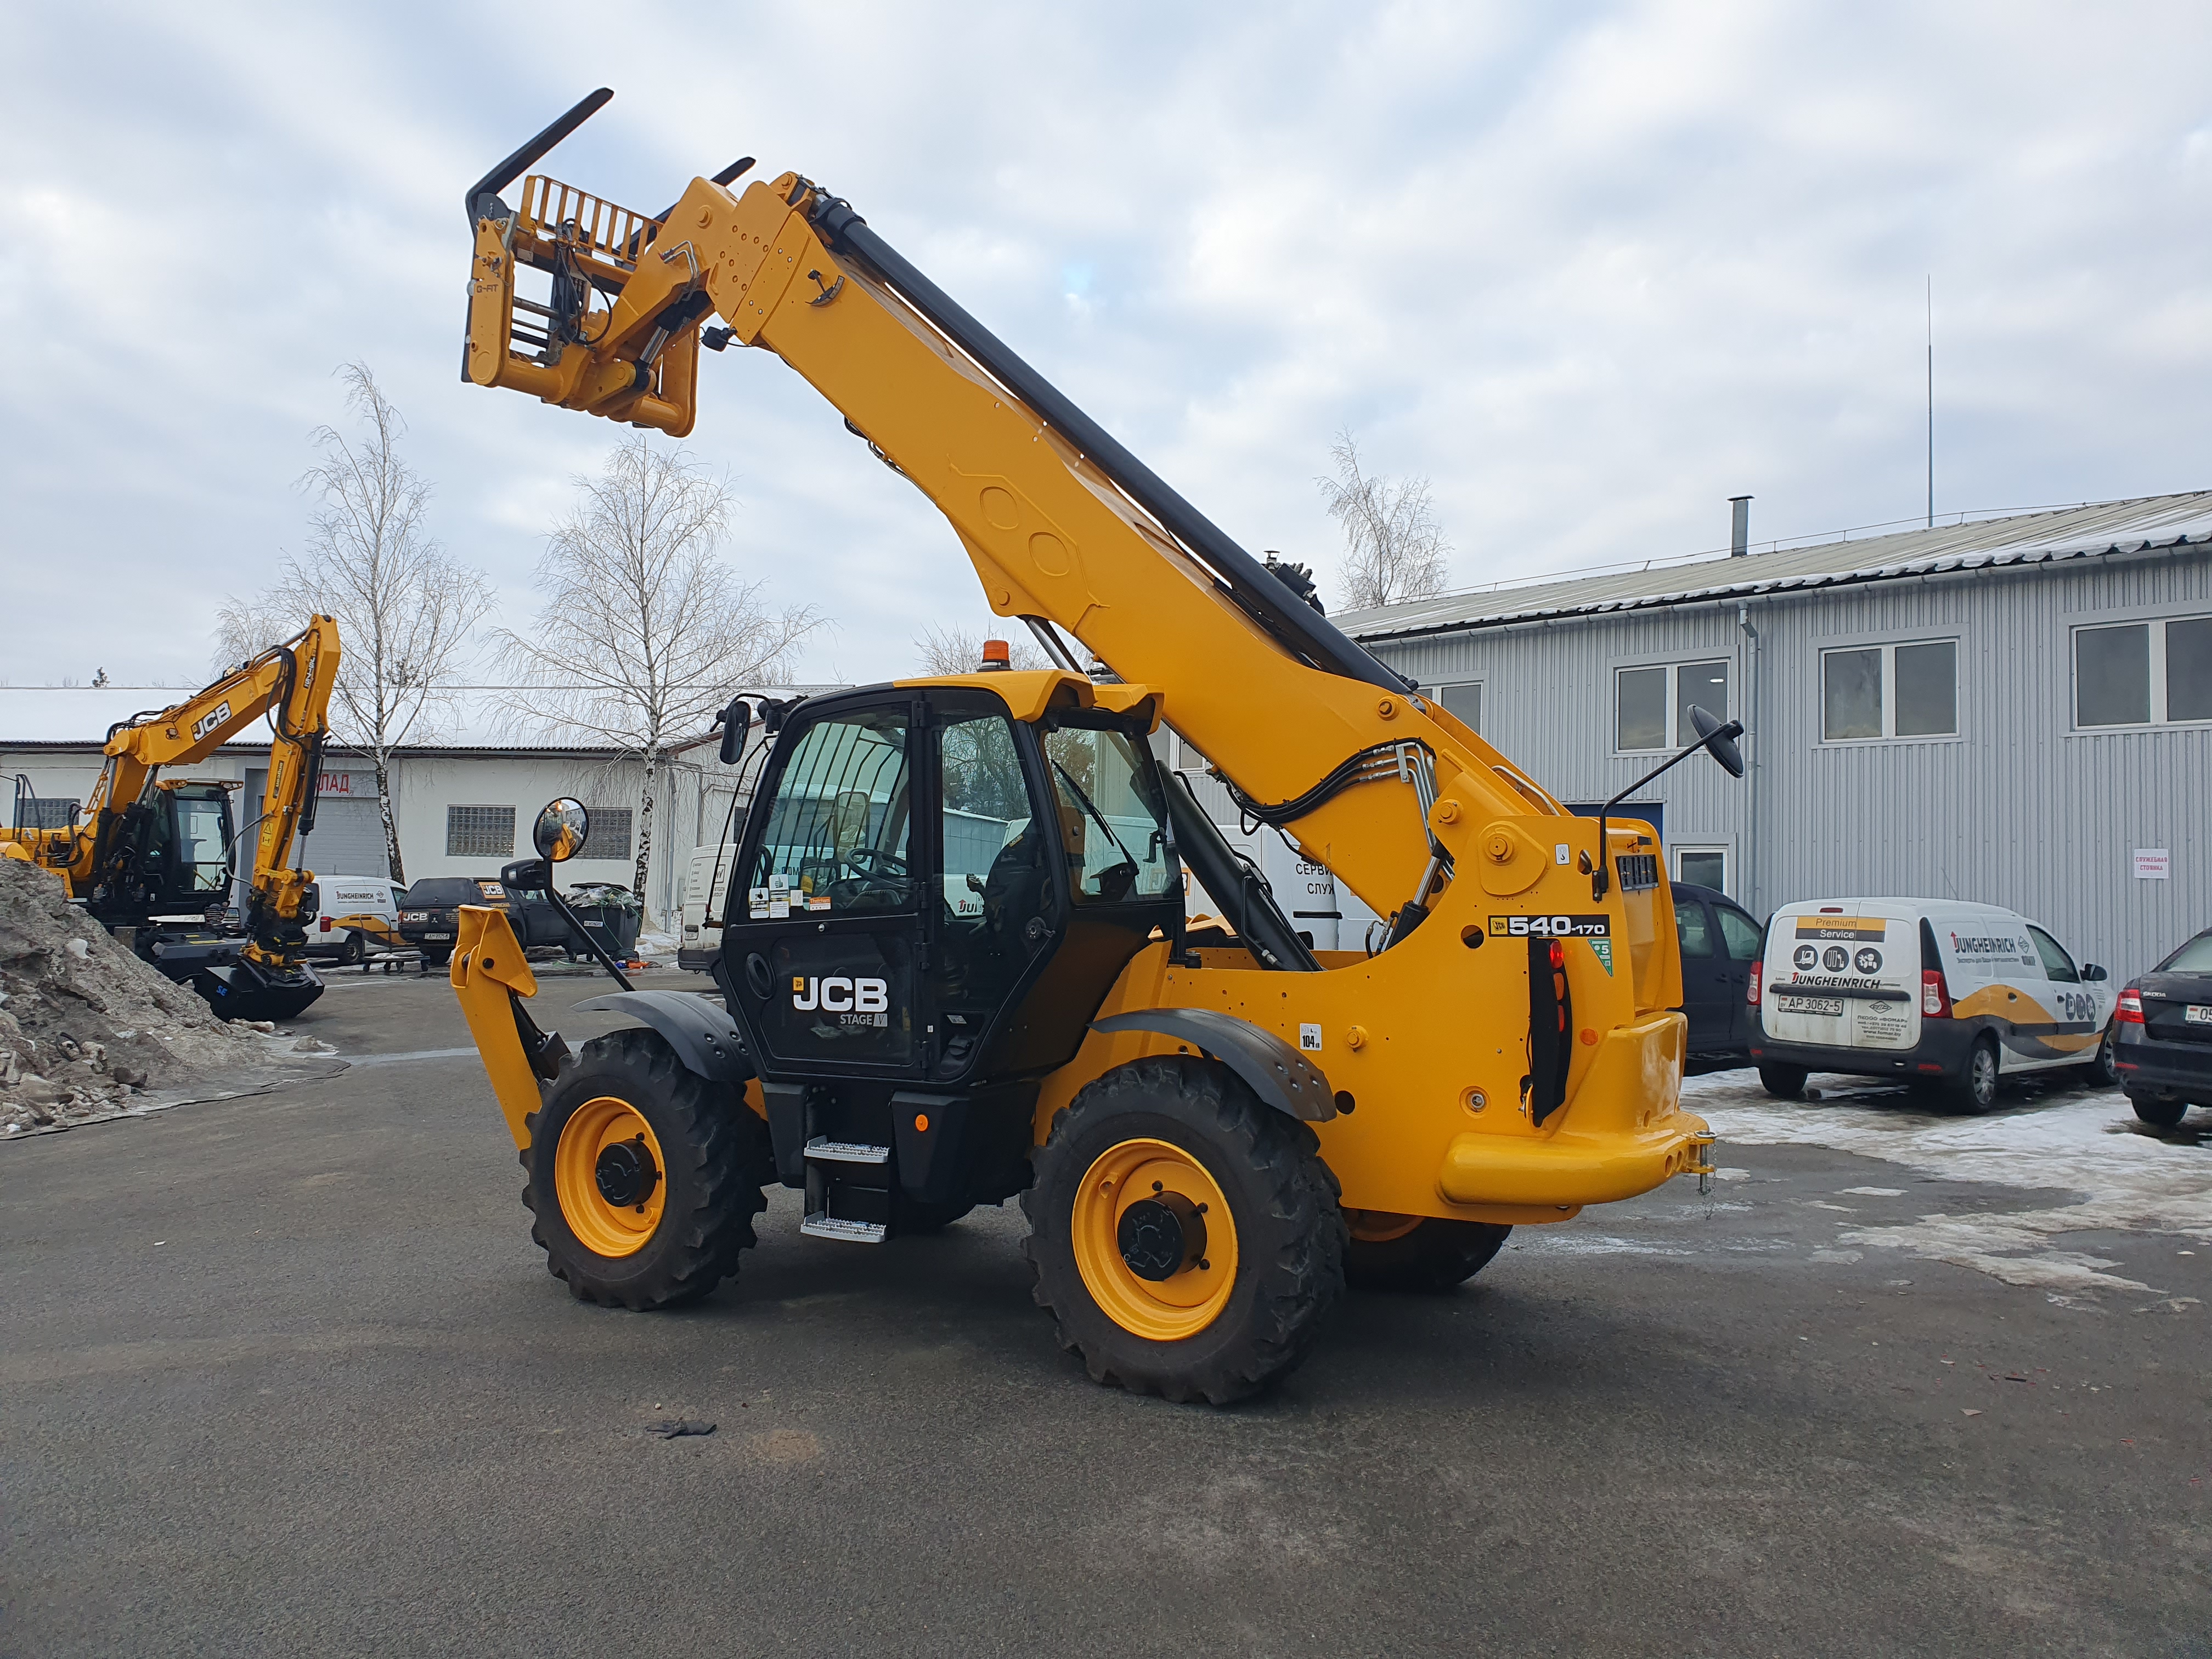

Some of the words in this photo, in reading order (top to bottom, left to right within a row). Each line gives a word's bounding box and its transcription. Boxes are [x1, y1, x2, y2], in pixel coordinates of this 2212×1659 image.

[194, 702, 232, 741] JCB
[319, 774, 349, 793] ЛАД
[1296, 864, 1332, 876] СЕРВИ
[484, 885, 503, 895] JCB
[1307, 883, 1334, 895] СЛУЖ
[403, 912, 428, 922] JCB
[1816, 918, 1857, 927] Premium
[1820, 929, 1855, 939] Service
[1601, 945, 1609, 954] 5
[1955, 937, 2017, 953] JUNGHEINRICH
[1792, 974, 1881, 989] JUNGHEINRICH
[793, 977, 888, 1013] JCB
[1805, 998, 1841, 1012] 3062-5
[840, 1014, 872, 1025] STAGE
[1302, 1035, 1314, 1048] 104
